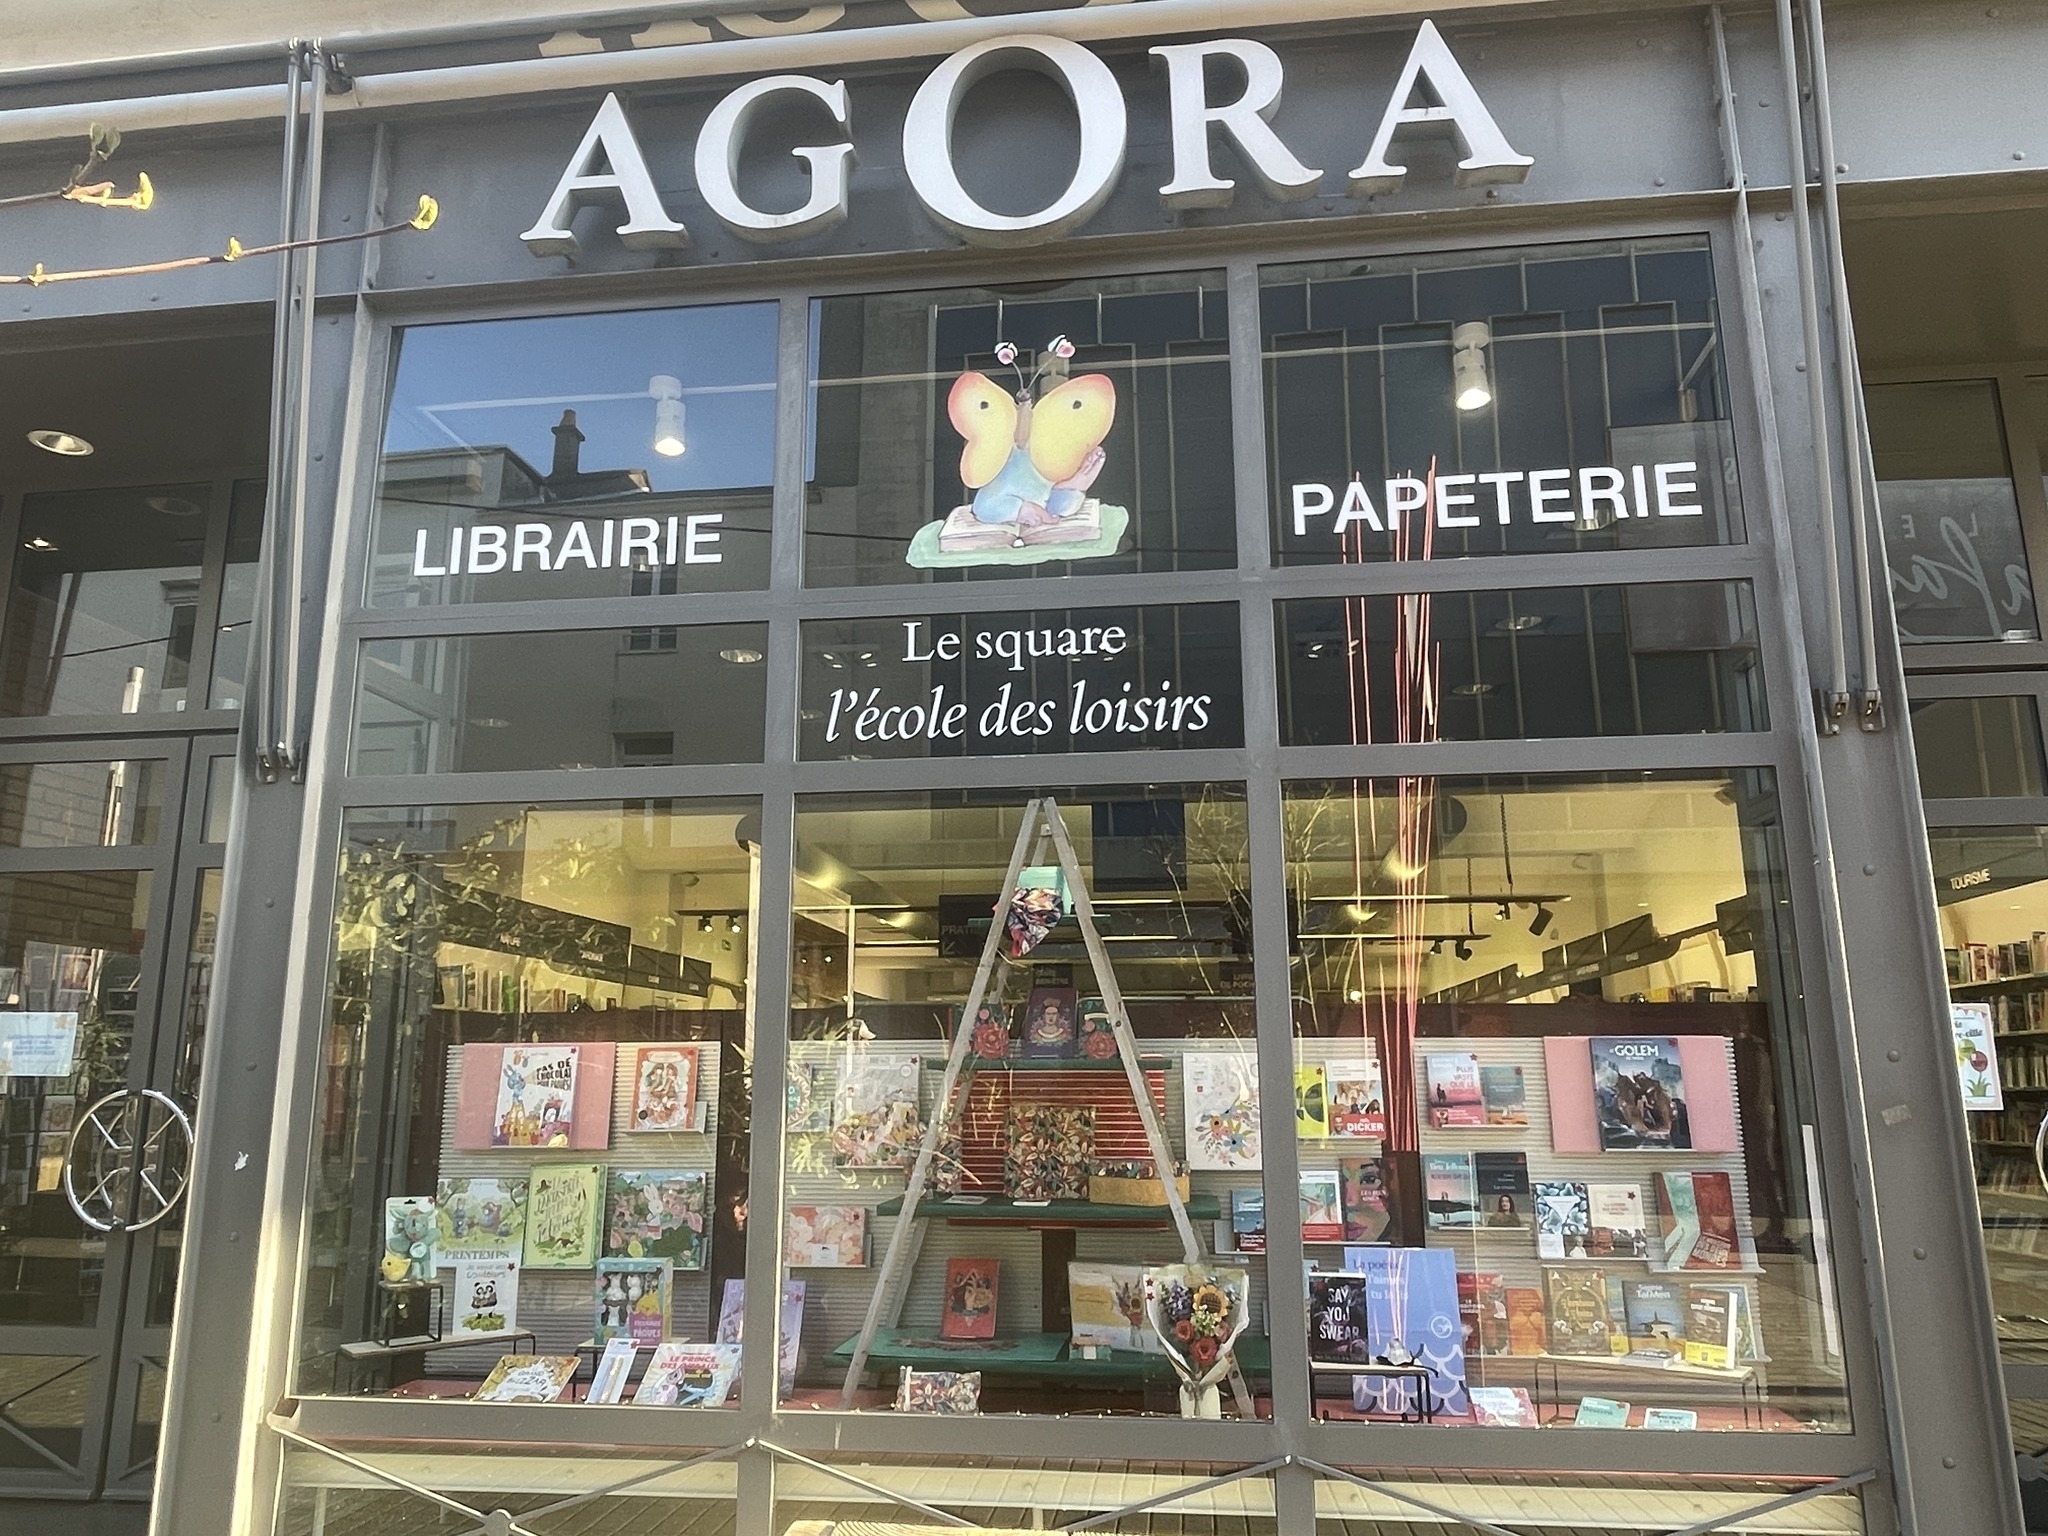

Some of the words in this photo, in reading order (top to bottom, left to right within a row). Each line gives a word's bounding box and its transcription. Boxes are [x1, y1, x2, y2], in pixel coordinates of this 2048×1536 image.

[520, 18, 1534, 247] AGORA
[1292, 461, 1702, 535] PAPETERIE
[413, 513, 723, 576] LIBRAIRIE
[902, 621, 961, 662] Le
[975, 625, 1127, 671] square
[825, 684, 969, 742] l'école
[979, 682, 1056, 738] des
[1068, 679, 1212, 736] loisirs
[1614, 1044, 1659, 1057] GOLEM
[1346, 1122, 1385, 1132] DICKER
[445, 1250, 510, 1260] PRINTEMPS
[1319, 1323, 1360, 1340] SWEAR
